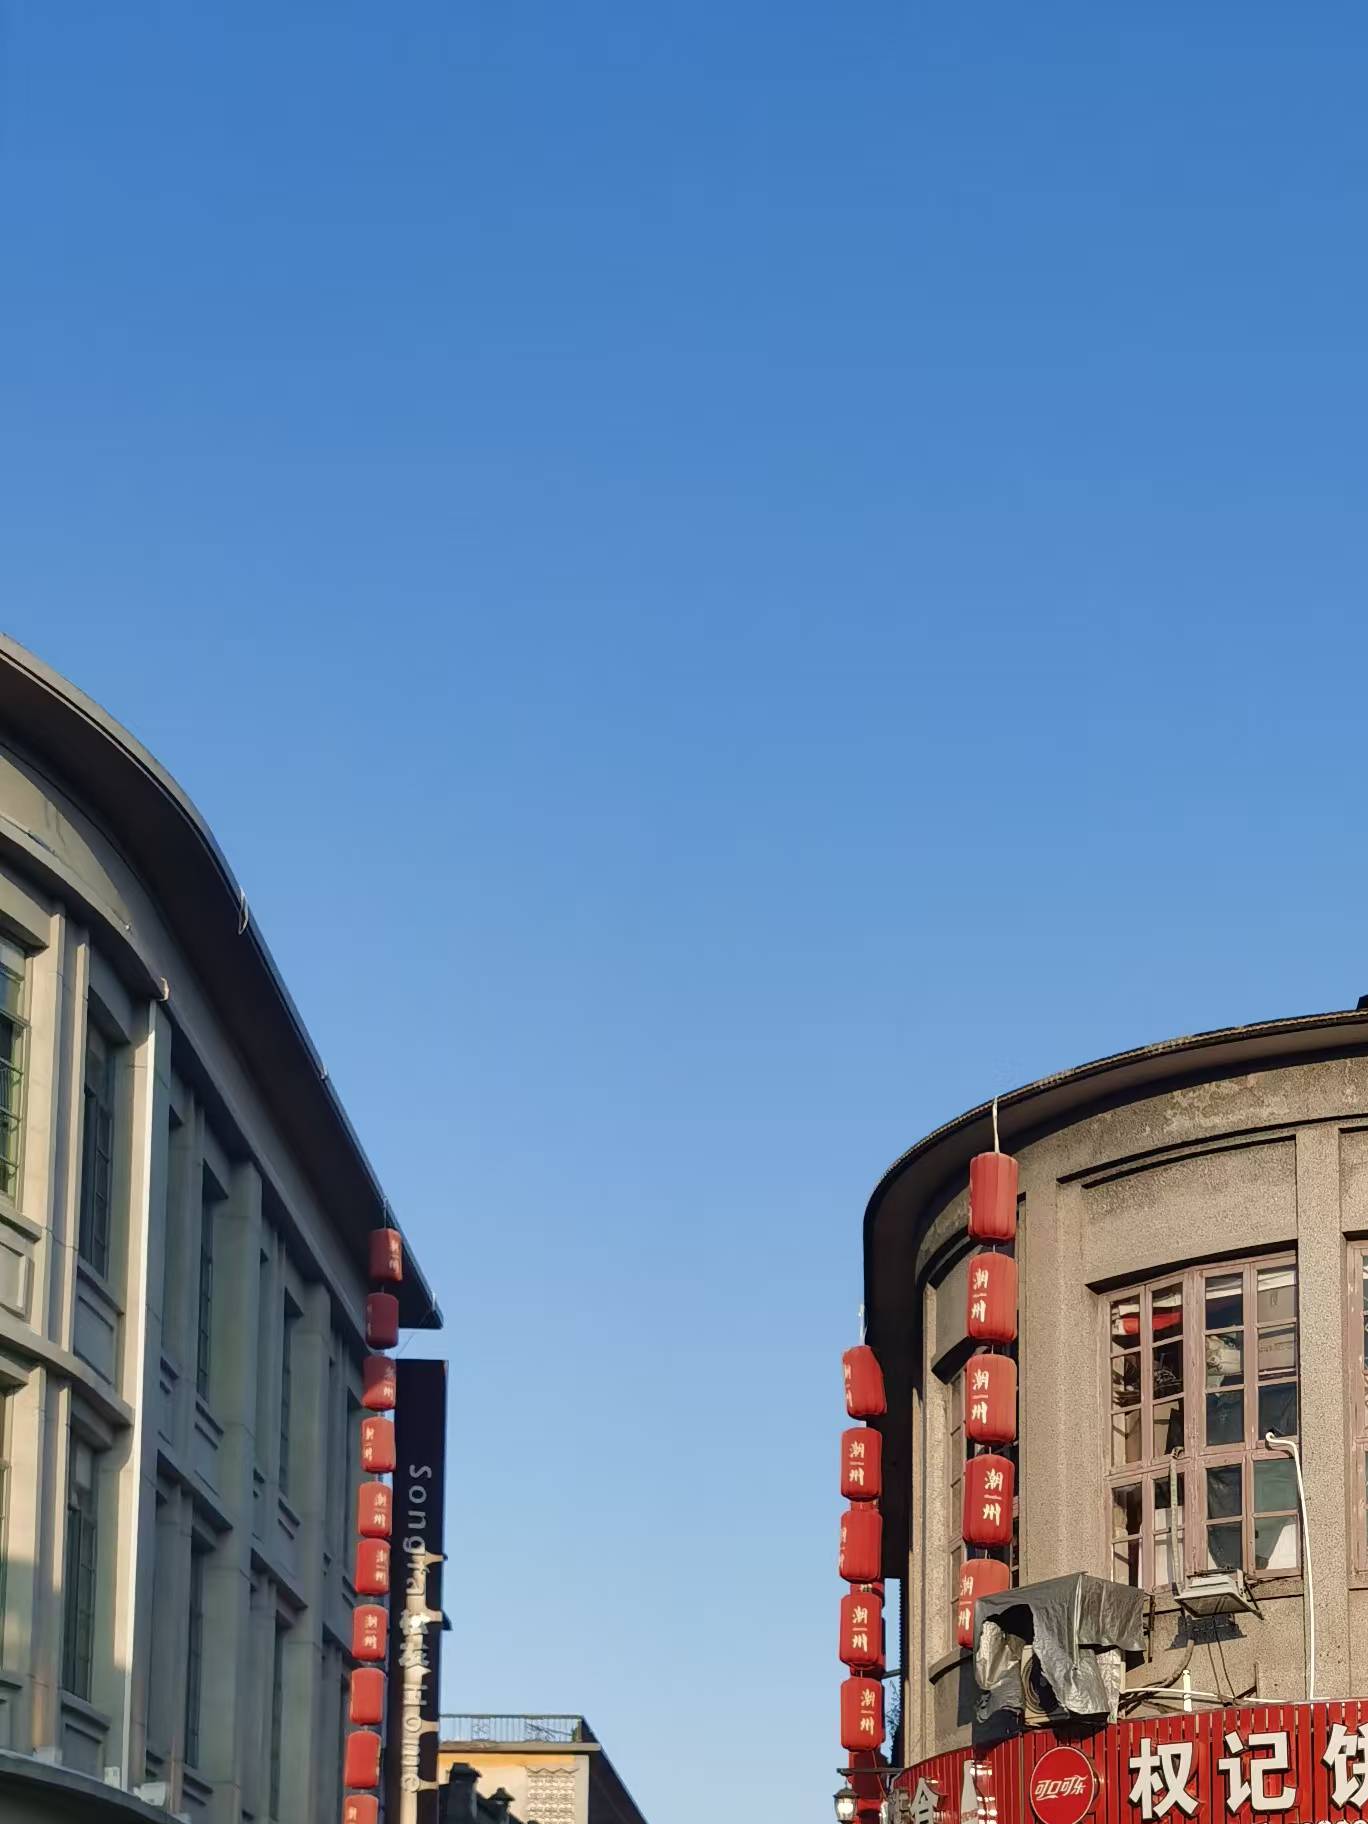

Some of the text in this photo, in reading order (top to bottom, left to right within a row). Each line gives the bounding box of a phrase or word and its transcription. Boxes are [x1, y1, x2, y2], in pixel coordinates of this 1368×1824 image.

[972, 1268, 989, 1323] 潮州
[971, 1369, 989, 1424] 潮州
[850, 1440, 865, 1486] 潮州
[983, 1468, 1003, 1526] 潮州
[958, 1575, 974, 1630] 潮州
[852, 1605, 867, 1653] 潮州
[860, 1688, 875, 1736] 潮州
[1034, 1774, 1088, 1801] 可口可乐
